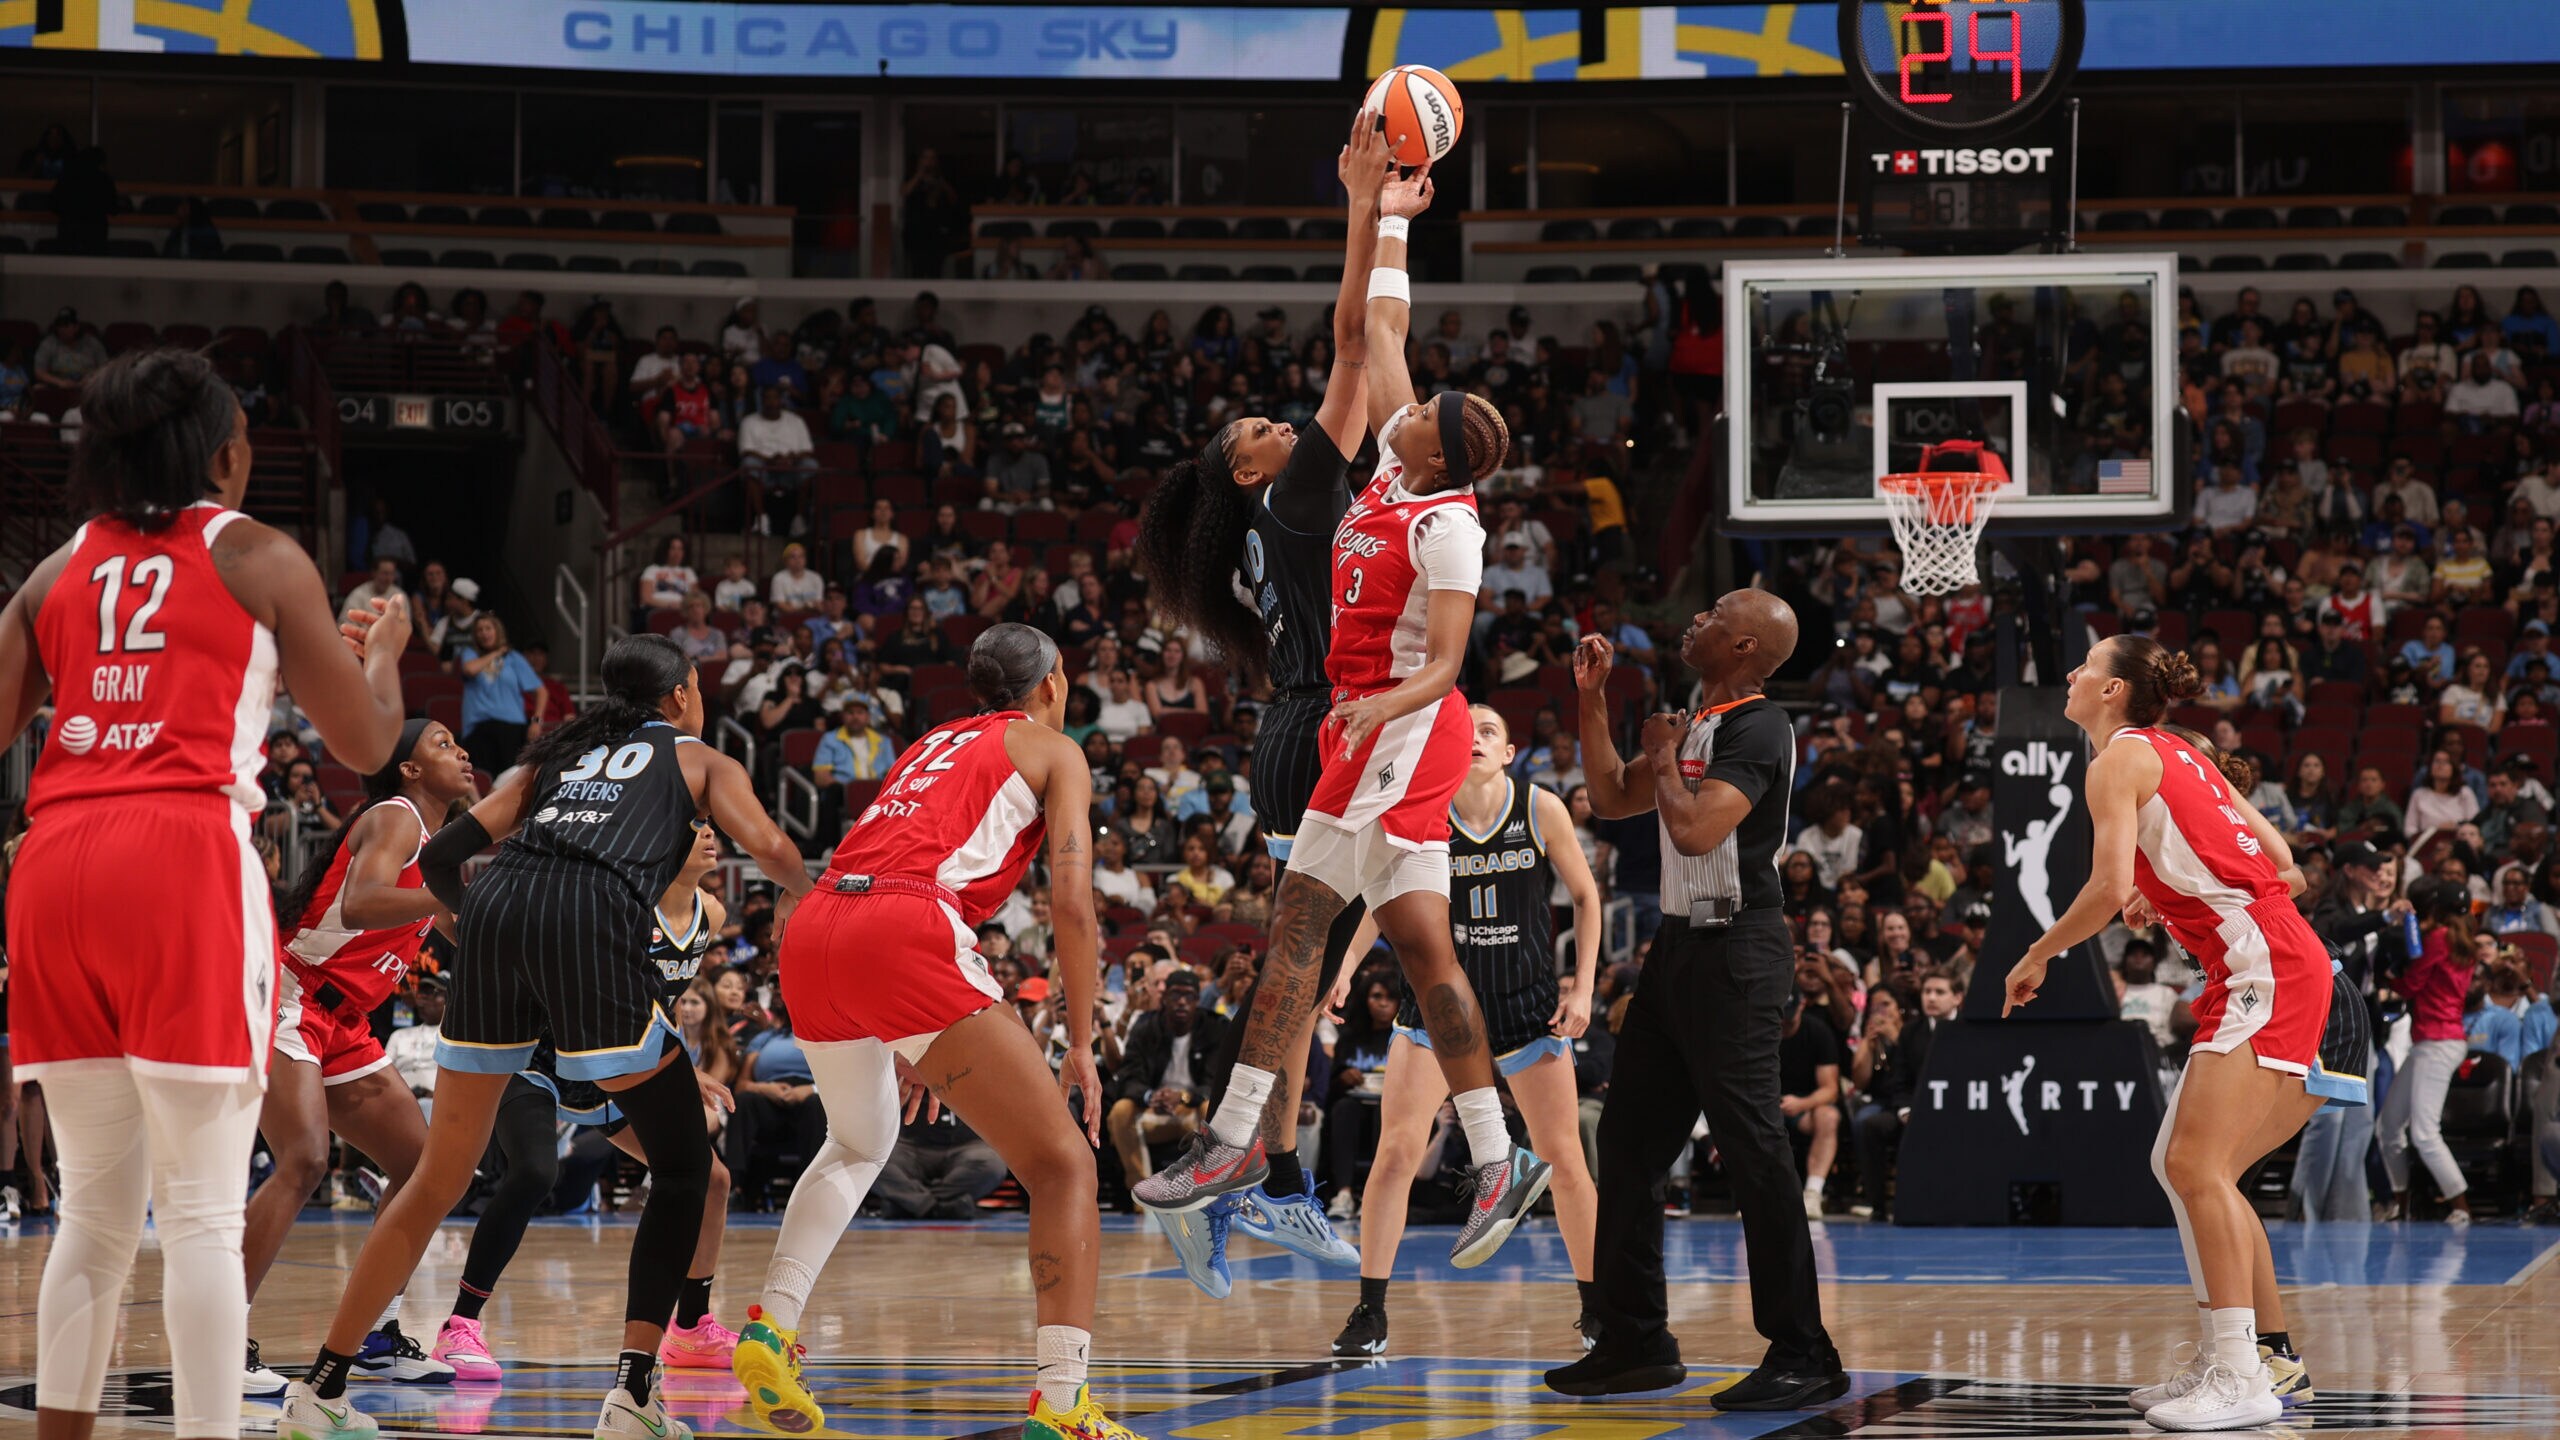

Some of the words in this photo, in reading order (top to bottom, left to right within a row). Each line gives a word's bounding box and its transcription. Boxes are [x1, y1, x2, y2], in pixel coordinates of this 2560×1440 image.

[563, 11, 999, 57] CHICAGO
[1036, 19, 1178, 60] SKY
[1900, 11, 2022, 103] 24
[1424, 91, 1449, 155] Wilson
[1920, 147, 2054, 175] TISSOT
[337, 398, 376, 423] 04
[397, 402, 425, 423] EXIT
[445, 400, 493, 426] 105
[1904, 409, 1956, 434] 106
[1332, 510, 1387, 570] Vegas
[1345, 567, 1364, 605] 3
[90, 554, 174, 654] 12
[92, 665, 150, 702] GRAY
[100, 721, 164, 750] AT&T
[560, 742, 654, 782] 30
[898, 730, 983, 778] 22
[2001, 742, 2073, 784] ally
[552, 781, 623, 802] STEVENS
[556, 810, 613, 824] AT&T
[1450, 848, 1535, 877] HICAGO
[1469, 884, 1498, 919] 11
[1469, 924, 1519, 936] UChicago
[1470, 935, 1519, 946] Medicine
